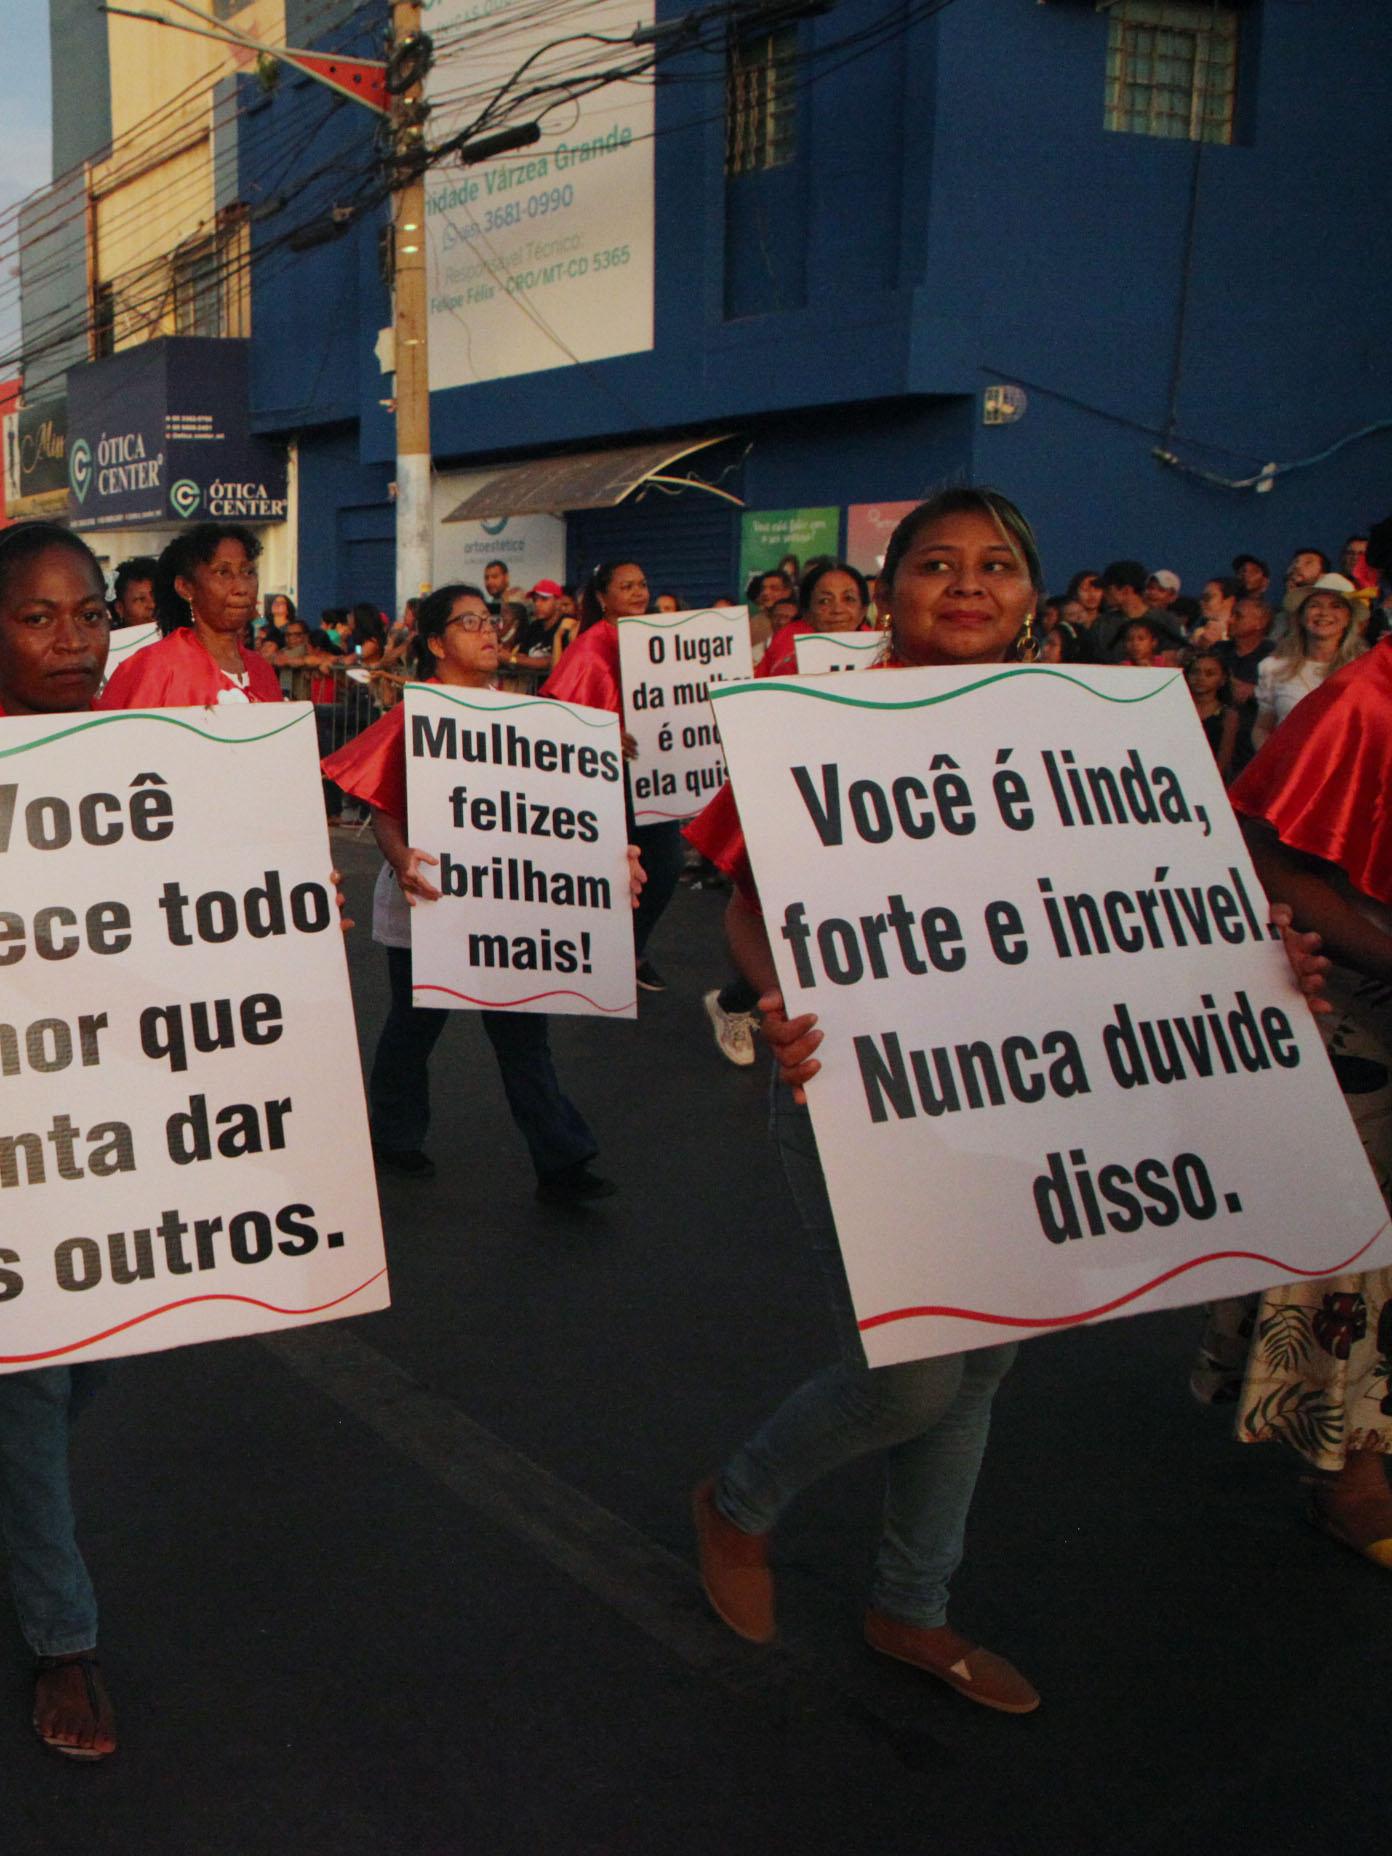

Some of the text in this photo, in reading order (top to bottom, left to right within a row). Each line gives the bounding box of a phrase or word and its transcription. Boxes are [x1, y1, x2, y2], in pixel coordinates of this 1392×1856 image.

[554, 124, 632, 170] Grande
[98, 432, 146, 466] ÓTICA
[98, 460, 160, 495] CENTER
[209, 479, 268, 499] ÓTICA
[210, 499, 285, 516] CENTER
[649, 634, 734, 665] O lugar
[632, 682, 665, 710] da
[411, 714, 620, 782] Mulheres
[659, 722, 673, 751] é
[635, 769, 677, 799] ela
[790, 748, 1212, 847] Você é linda,
[448, 786, 599, 842] felizes
[158, 870, 331, 946] todo
[440, 852, 612, 909] brilham
[468, 928, 592, 974] mais!
[781, 866, 1283, 989] forte e incrível.
[139, 992, 284, 1072] que
[853, 990, 1300, 1123] Nunca duvide
[166, 1093, 292, 1165] dar
[1033, 1148, 1243, 1245] disso.
[54, 1202, 345, 1292] outros.
